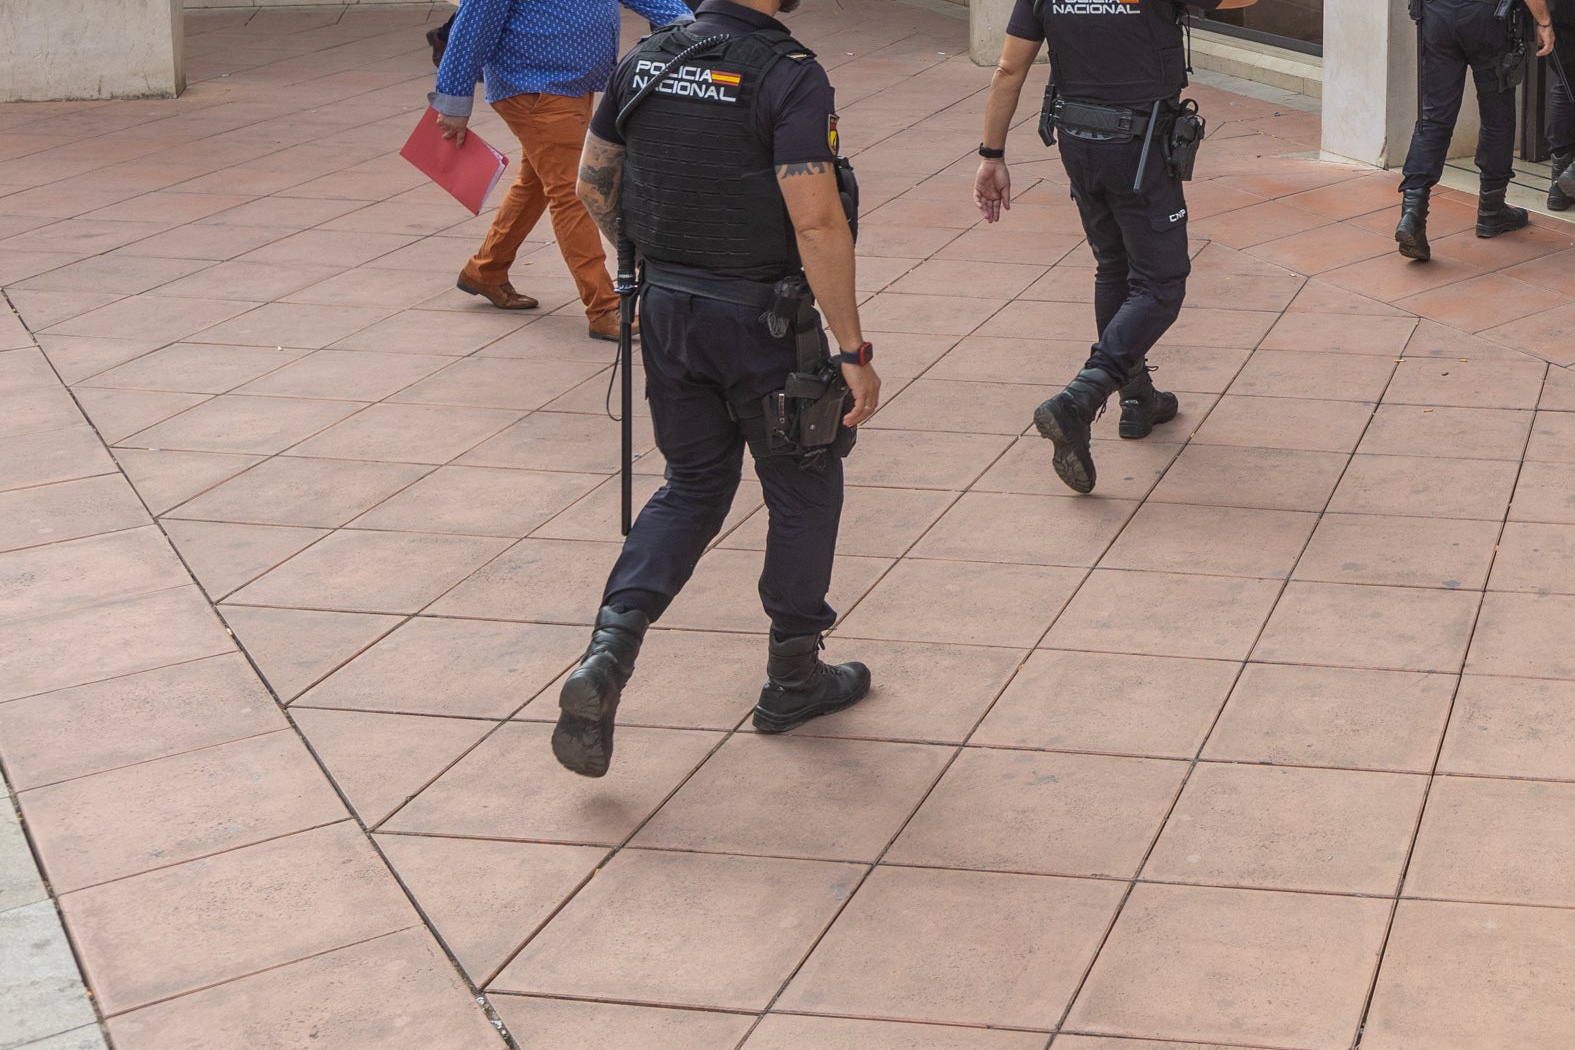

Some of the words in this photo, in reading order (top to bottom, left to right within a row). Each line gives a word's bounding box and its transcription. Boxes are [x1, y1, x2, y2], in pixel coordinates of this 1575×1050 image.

[1052, 3, 1141, 14] NACIONAL
[632, 75, 737, 102] NCIONAL
[1169, 209, 1186, 222] CNP
